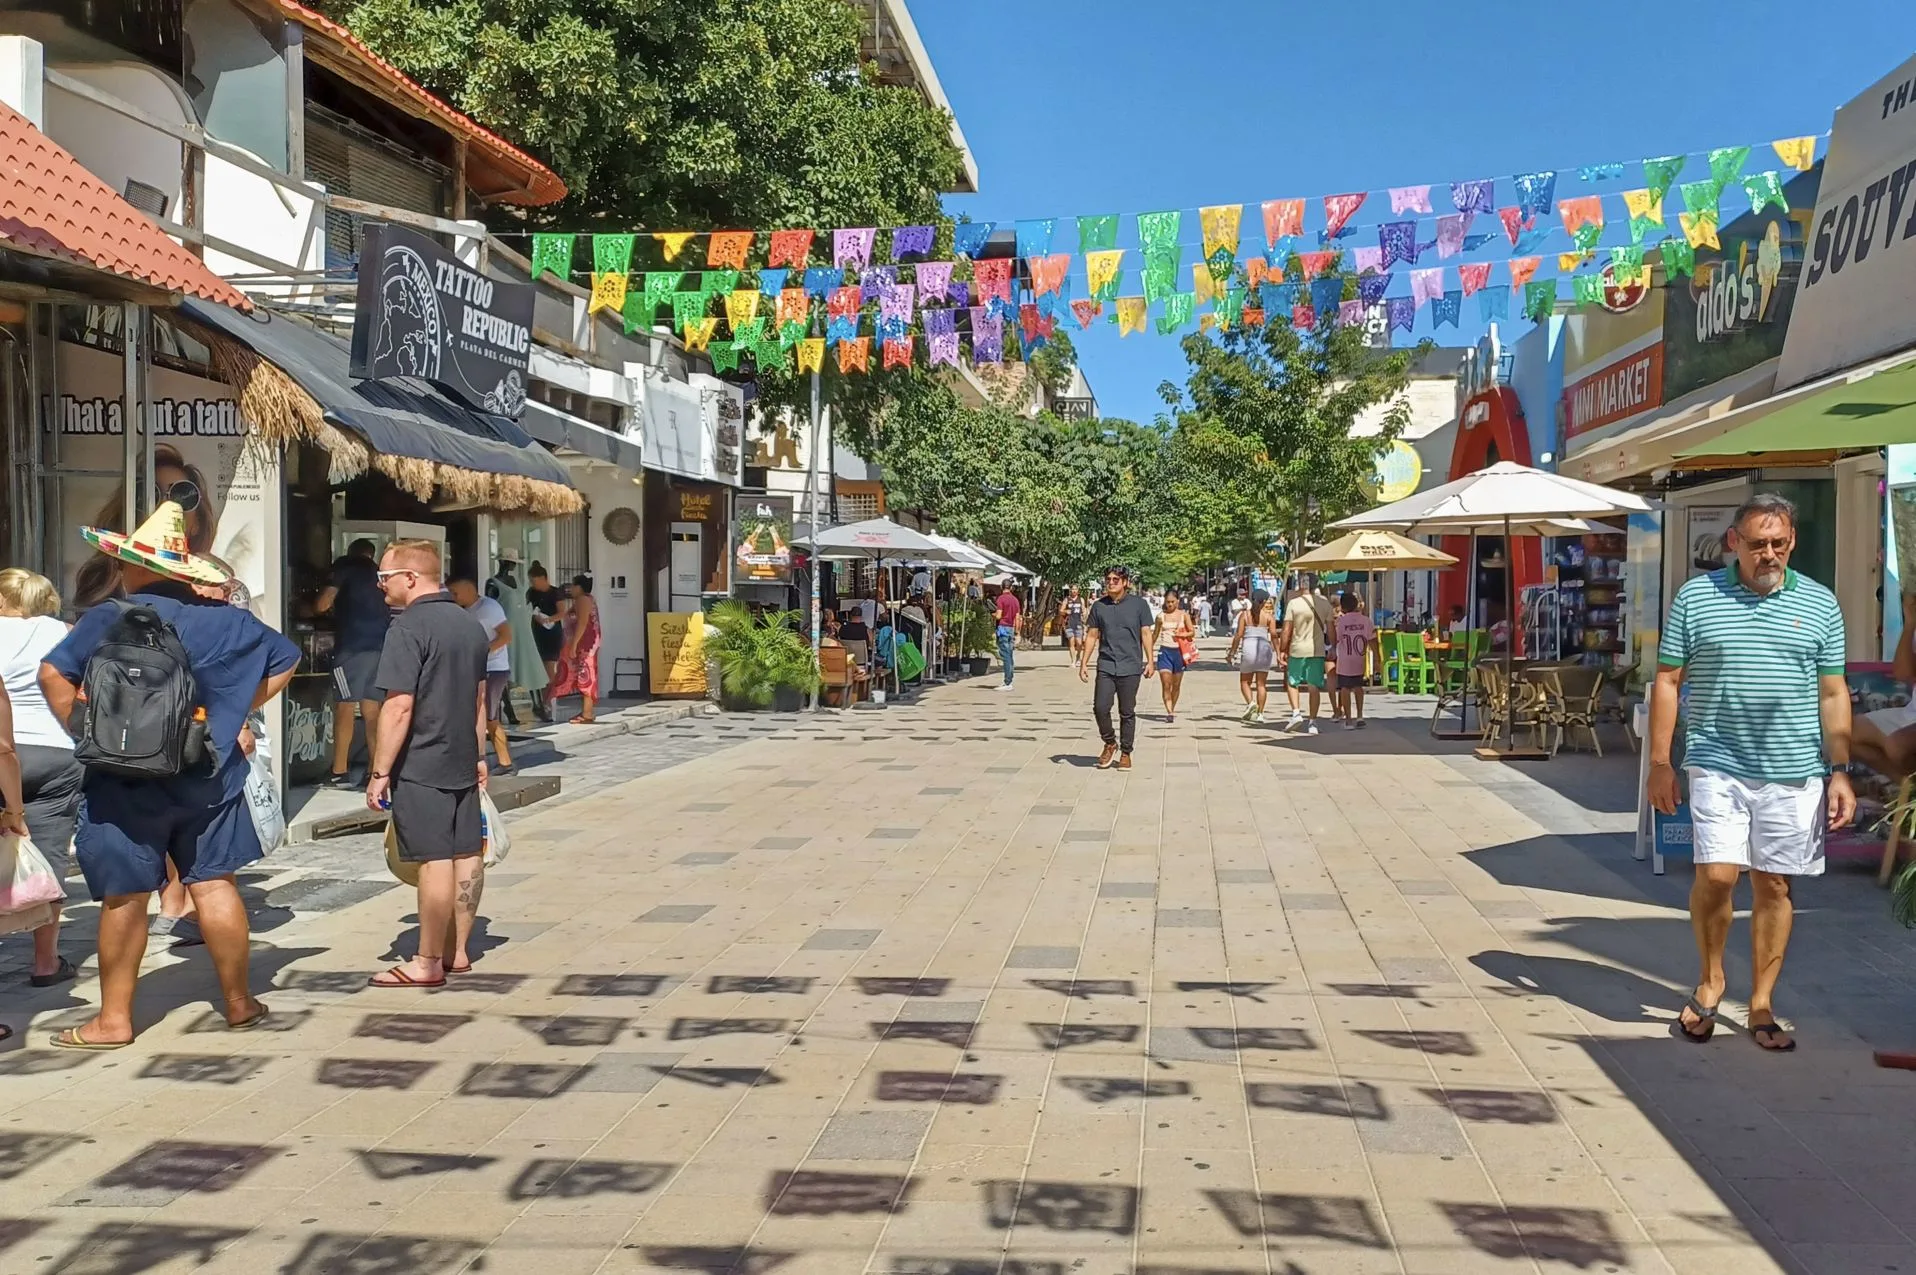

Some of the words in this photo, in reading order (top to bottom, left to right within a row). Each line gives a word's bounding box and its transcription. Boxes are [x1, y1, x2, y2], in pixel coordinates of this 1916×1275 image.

[411, 262, 436, 335] MEXICO
[435, 258, 493, 309] TATTOO
[461, 305, 529, 353] REPUBLIC
[460, 340, 482, 355] PLAYA
[484, 348, 497, 360] DEL
[499, 353, 526, 369] CARMEN
[1596, 357, 1650, 418] MARKET
[179, 401, 192, 434] a
[195, 398, 258, 435] tatto
[217, 492, 247, 501] Follow
[663, 649, 691, 662] Hotel
[1343, 634, 1367, 657] 10
